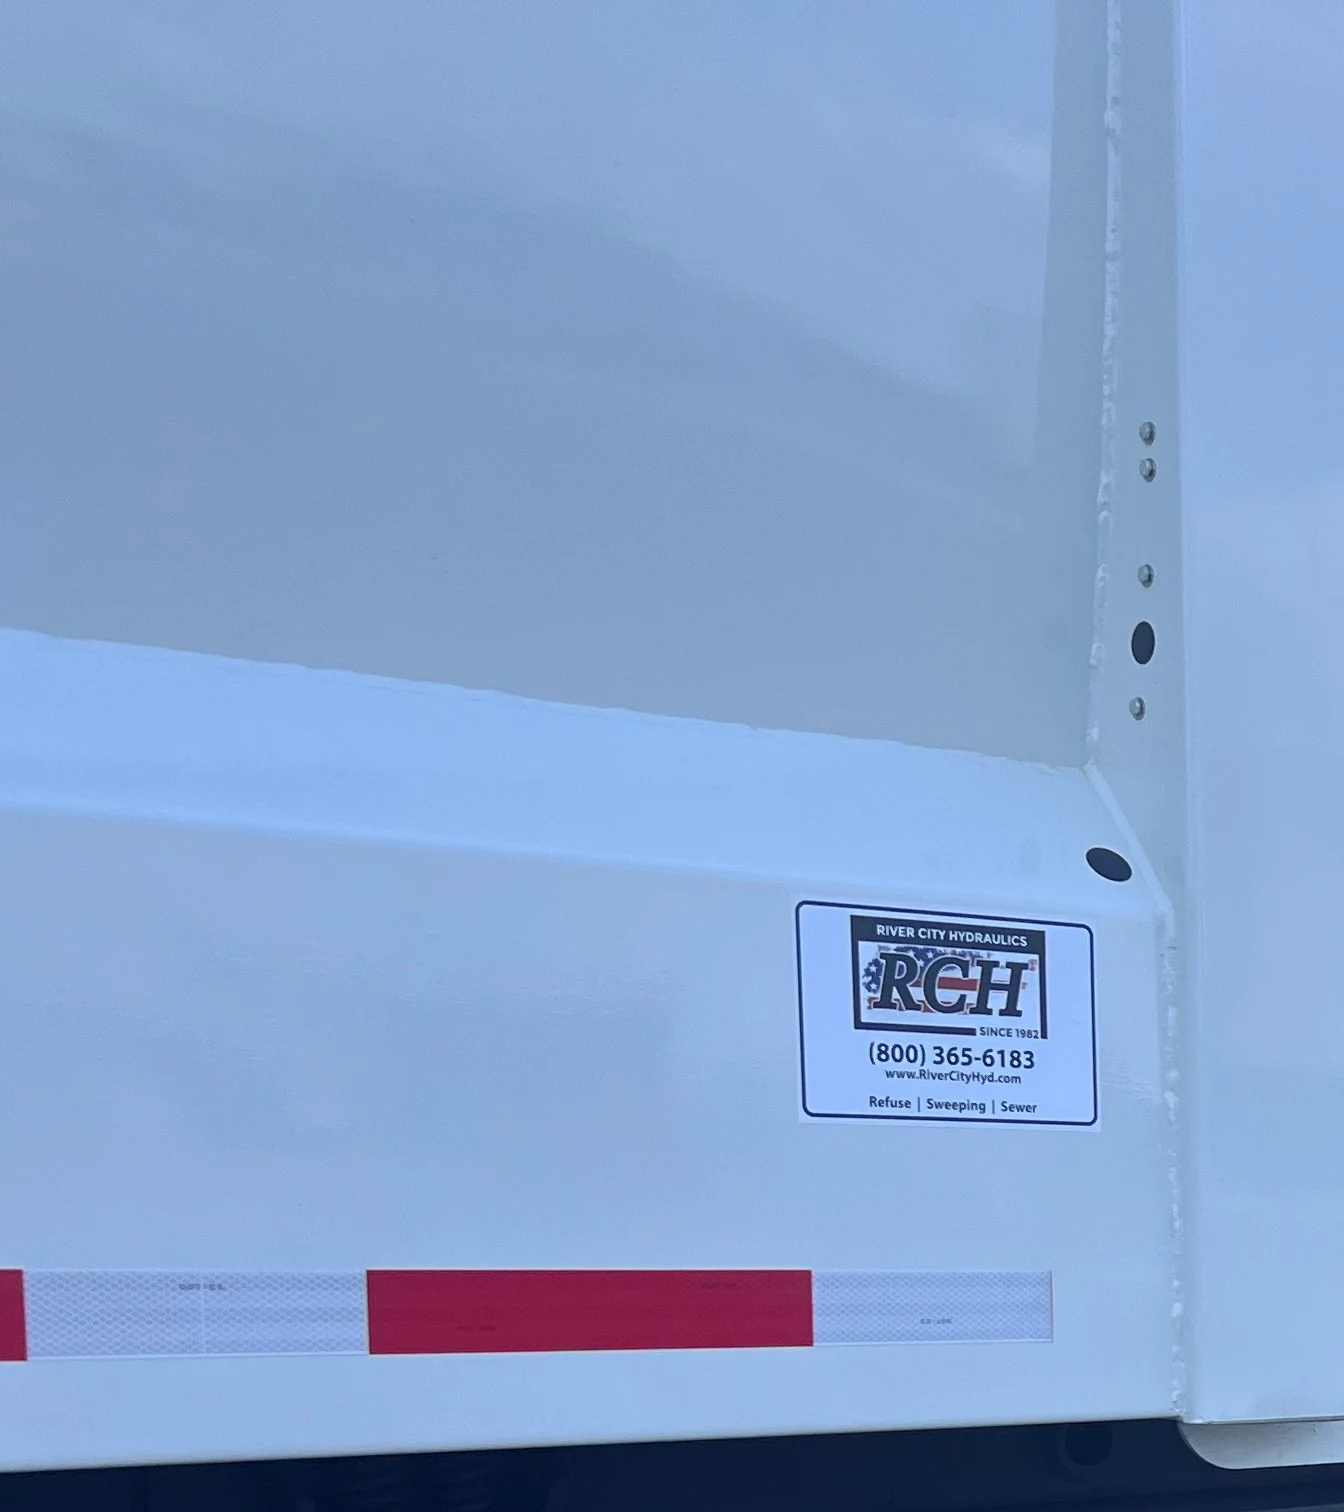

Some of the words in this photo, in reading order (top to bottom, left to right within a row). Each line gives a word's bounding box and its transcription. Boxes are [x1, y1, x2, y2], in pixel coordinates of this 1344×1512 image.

[876, 923, 915, 939] RIVER
[918, 927, 947, 941] CITY
[949, 930, 1028, 947] HYDRAULICS
[872, 951, 1029, 1018] RCH
[979, 1027, 1013, 1039] SINCE
[1016, 1028, 1039, 1040] 1982
[869, 1042, 926, 1066] (800)
[932, 1046, 1036, 1069] 365-6183
[885, 1069, 1022, 1086] www.RiverCityHyd.com
[869, 1096, 912, 1109] Refuse
[926, 1098, 986, 1114] Sweeping
[1000, 1101, 1037, 1114] Sewer
